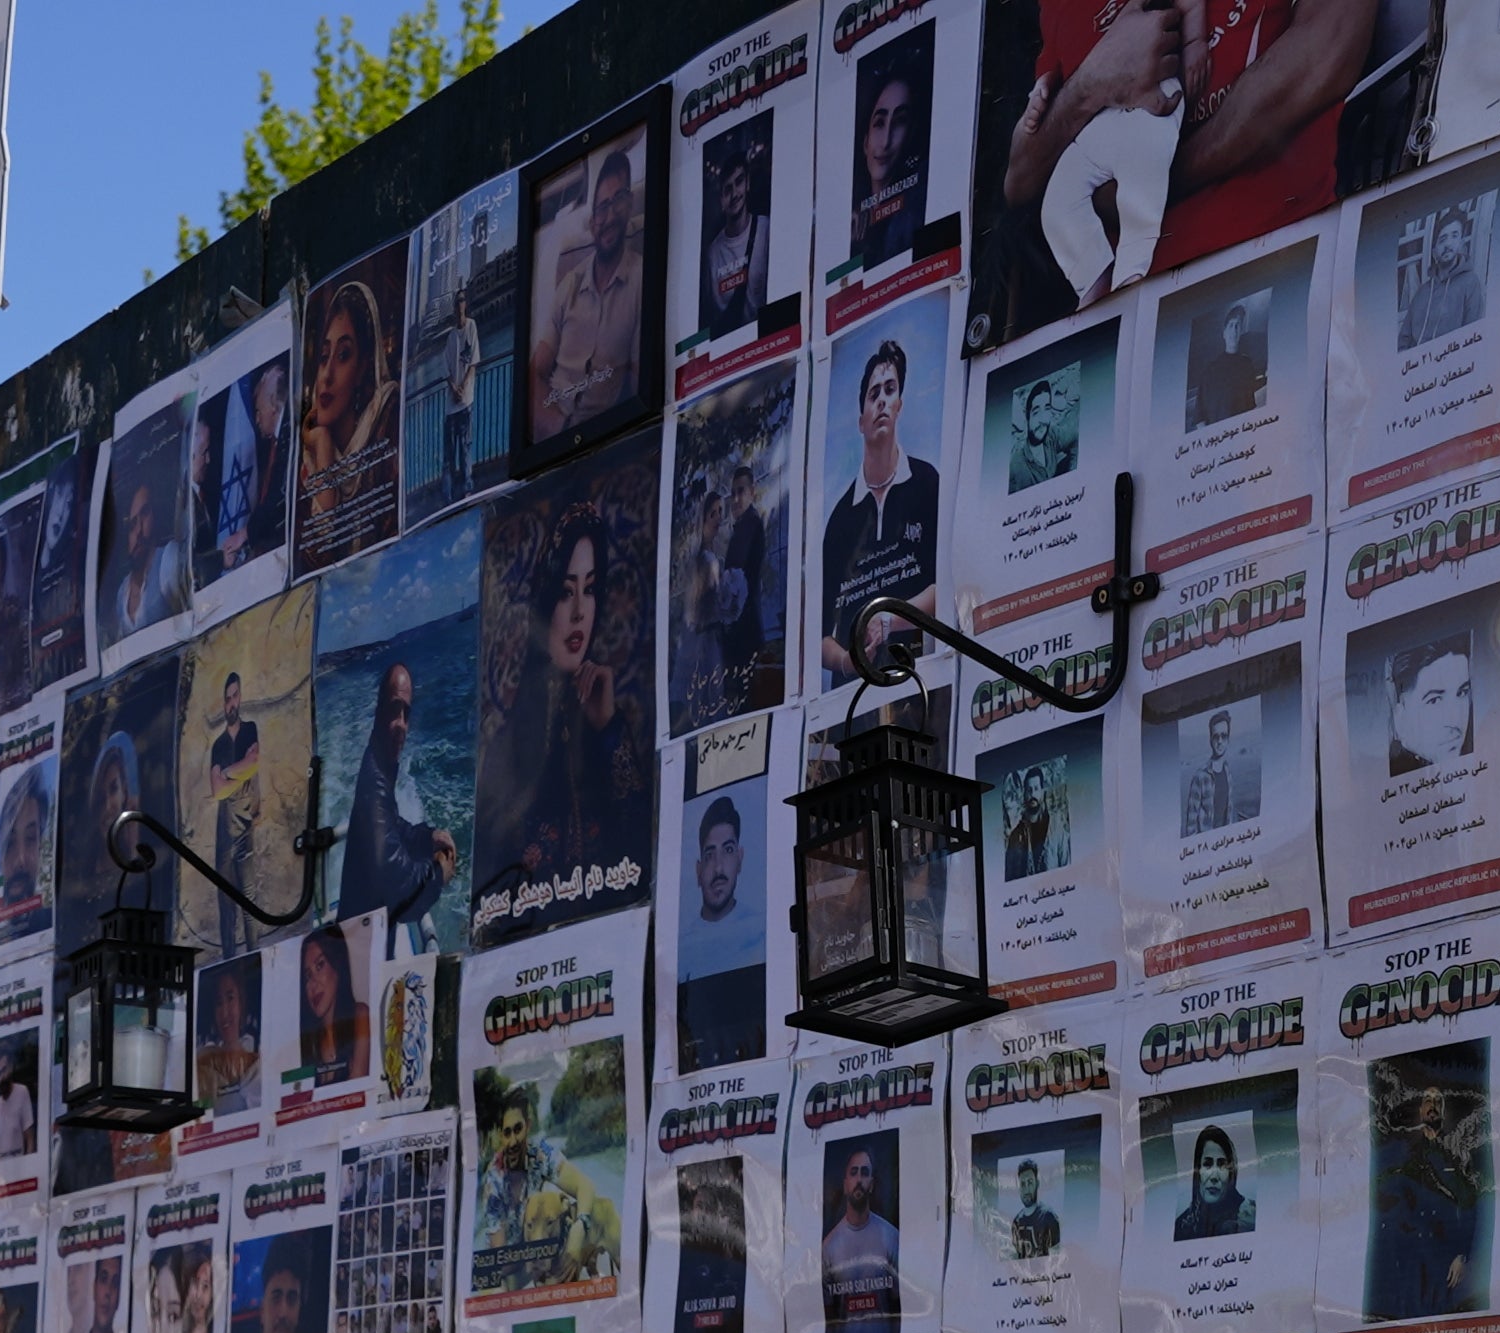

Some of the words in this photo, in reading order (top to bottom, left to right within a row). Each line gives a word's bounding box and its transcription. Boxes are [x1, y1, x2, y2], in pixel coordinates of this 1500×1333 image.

[708, 46, 741, 76] STOP
[744, 31, 771, 57] THE
[679, 33, 809, 138] GENOCIDE
[835, 595, 846, 609] 27
[845, 587, 866, 605] years
[879, 574, 899, 592] from
[899, 565, 922, 586] Arak
[839, 569, 874, 593] Mehrdad
[515, 965, 548, 987] STOP
[552, 957, 577, 978] THE
[484, 970, 614, 1046] GENOCIDE
[473, 1255, 495, 1268] Reza
[496, 1243, 560, 1265] Eskandarpour
[472, 1274, 488, 1289] Age
[491, 1271, 501, 1286] 37
